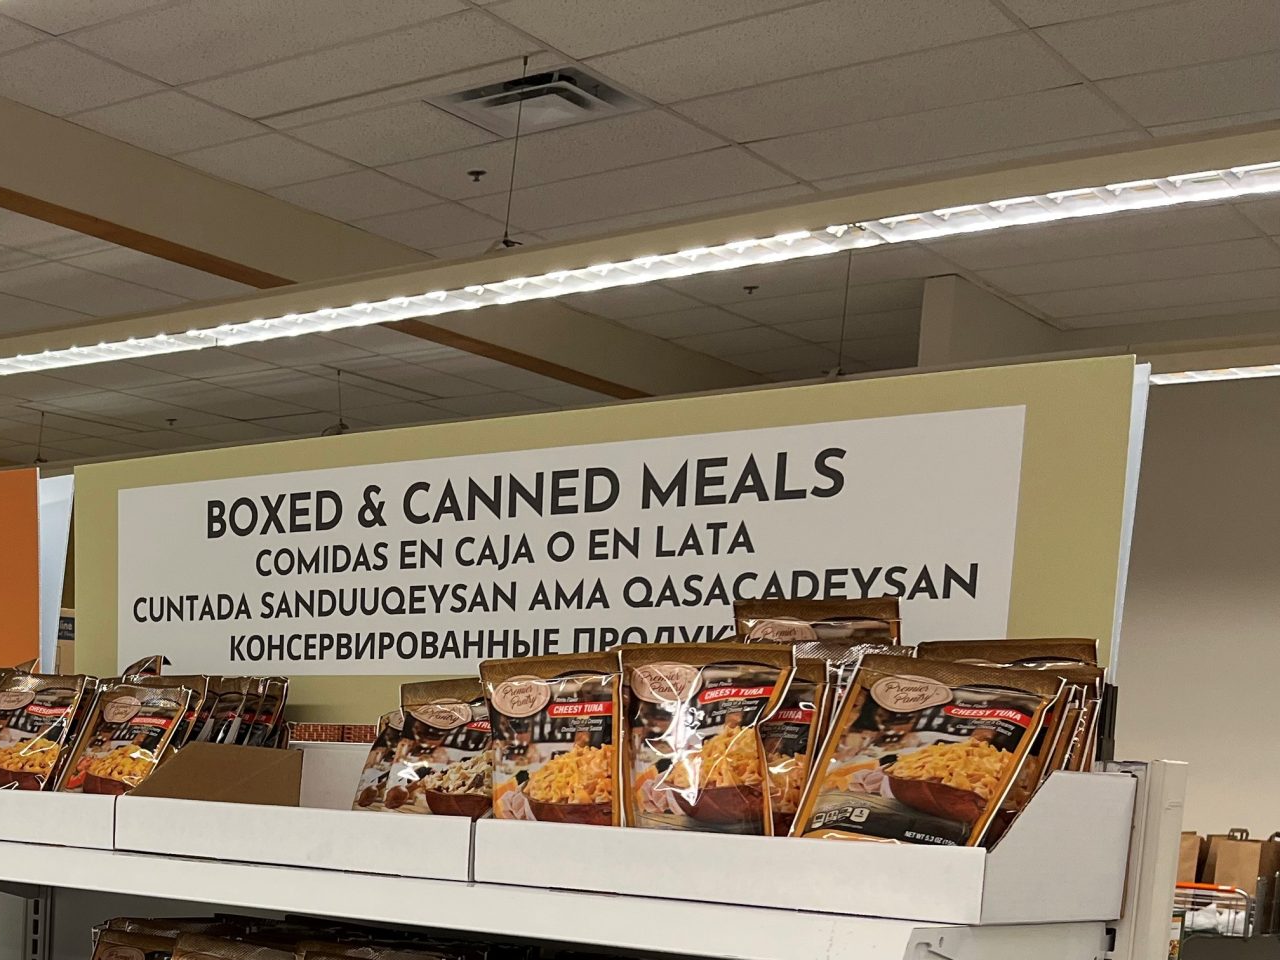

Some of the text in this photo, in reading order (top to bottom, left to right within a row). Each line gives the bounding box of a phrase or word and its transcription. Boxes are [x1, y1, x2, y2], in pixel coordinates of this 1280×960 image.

[207, 447, 847, 539] BOXED & CANNED MEALS
[255, 520, 755, 577] COMIDAS EN CAJA O EN LATA
[133, 562, 979, 623] CUNTADA SANDUUQEYSAN AMA QASACADEYSAN
[229, 624, 733, 661] КОНСЕРВИРОВАННЫЕ ПРОДУК
[501, 684, 533, 699] Premier
[705, 687, 763, 700] CHEESY TUNA
[885, 681, 929, 695] Premier
[510, 694, 537, 709] Pantry
[894, 692, 932, 705] Pantry
[553, 703, 603, 714] CHEESY TUNA
[951, 707, 1021, 721] CHEESY TUNA
